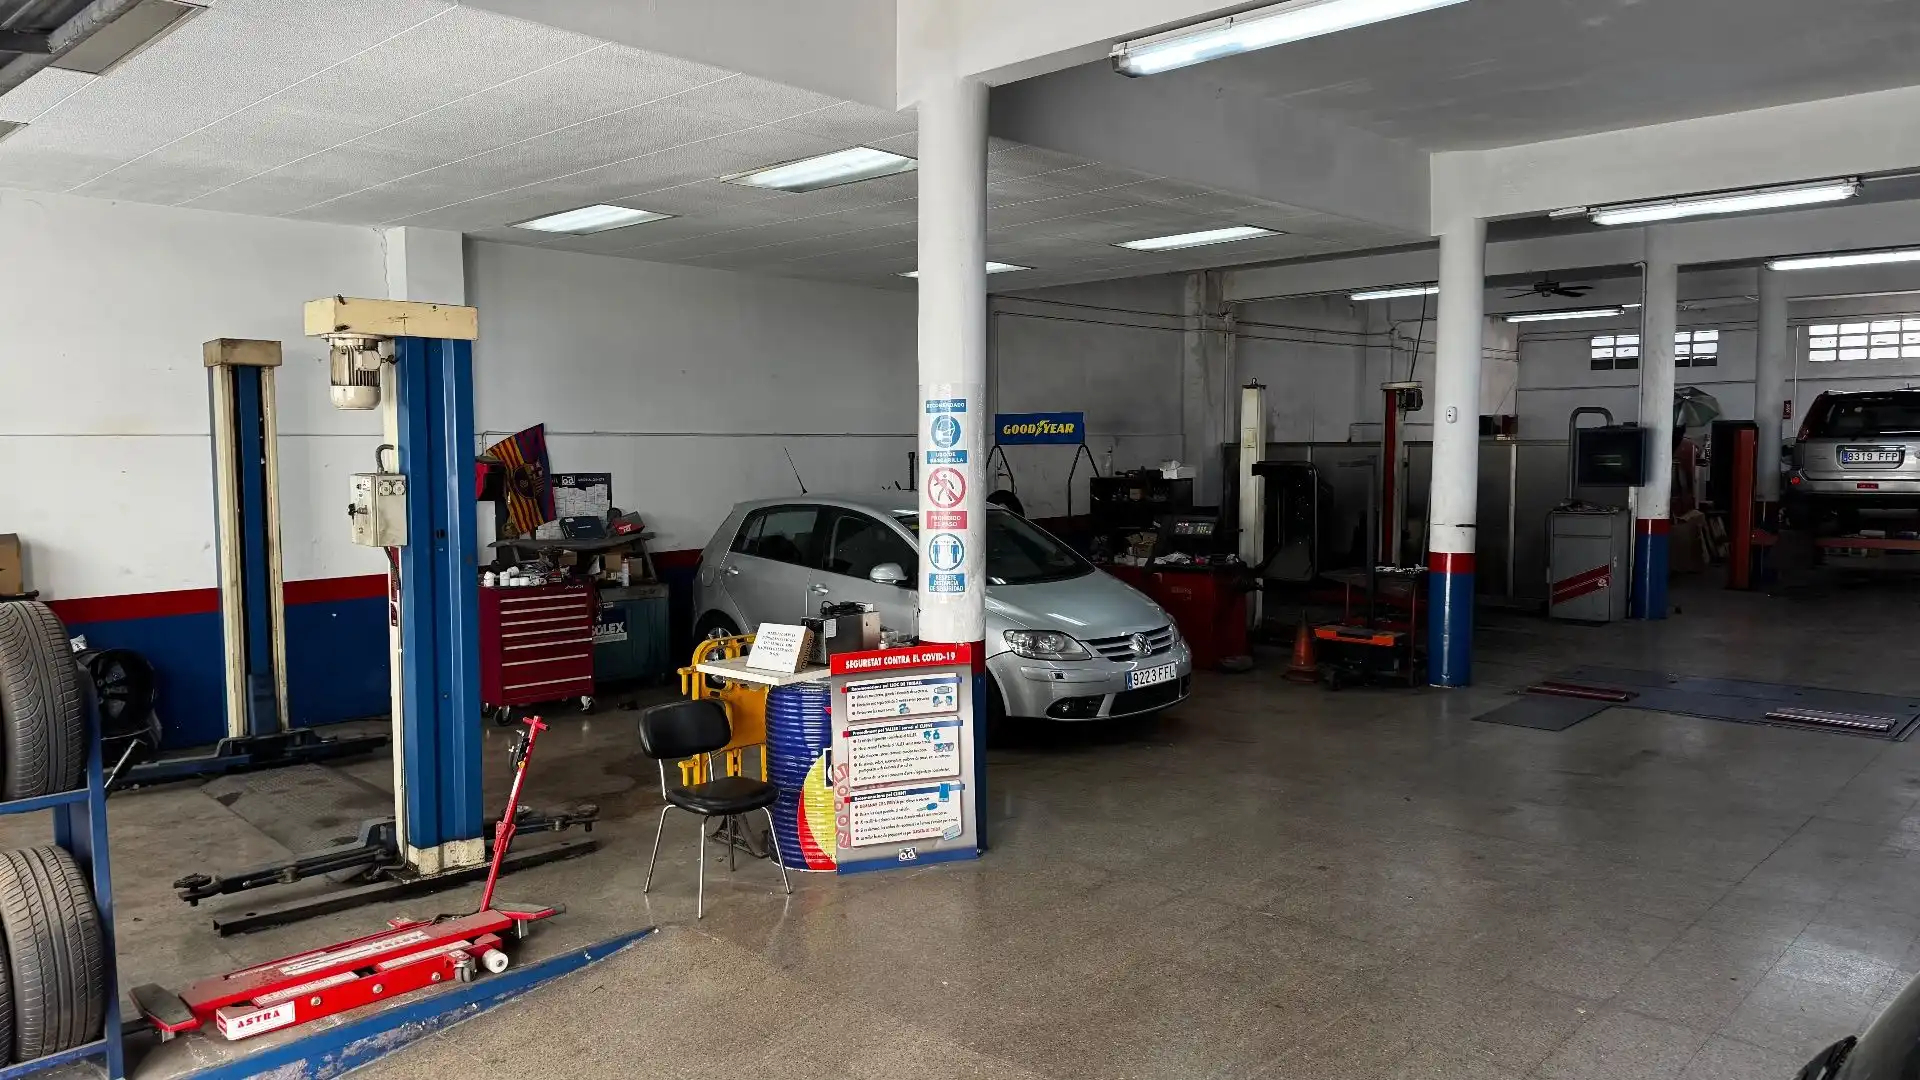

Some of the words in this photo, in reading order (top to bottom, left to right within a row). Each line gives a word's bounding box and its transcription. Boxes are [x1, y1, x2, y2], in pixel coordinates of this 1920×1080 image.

[1002, 422, 1075, 435] GOODYEAR
[1848, 452, 1873, 461] 8319
[1878, 452, 1898, 461] FFP
[845, 657, 882, 669] SEGURETAT
[883, 655, 911, 666] CONTRA
[912, 653, 920, 663] EL
[921, 651, 956, 662] COVID-19
[1133, 669, 1157, 686] 9223
[1158, 665, 1175, 681] FFL
[237, 1010, 280, 1028] ASTRA
